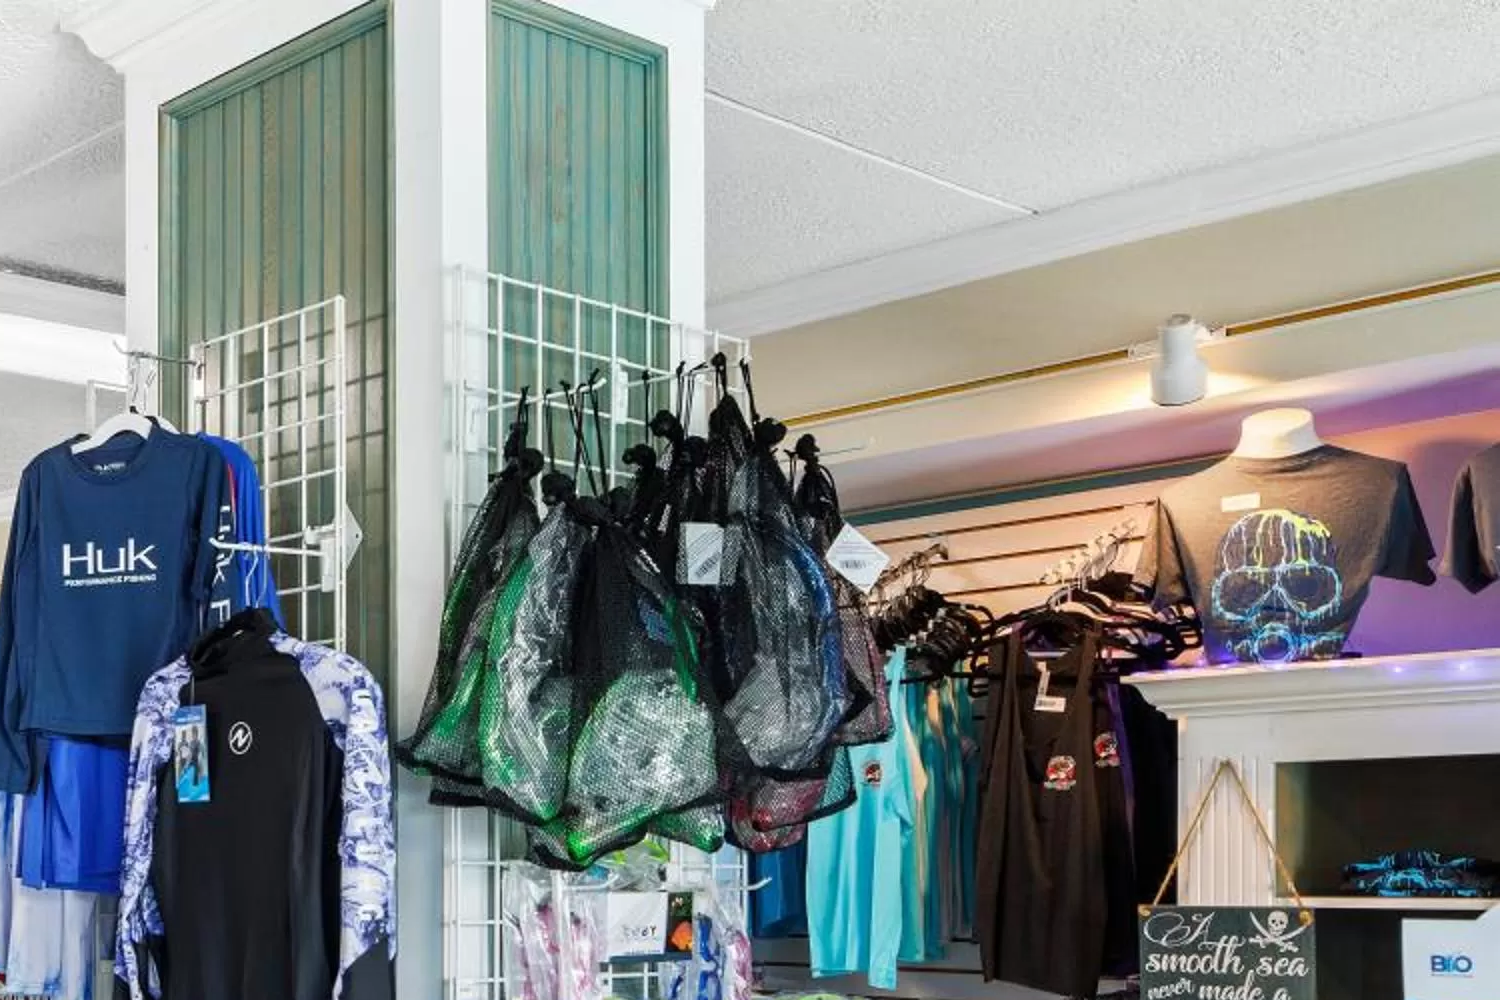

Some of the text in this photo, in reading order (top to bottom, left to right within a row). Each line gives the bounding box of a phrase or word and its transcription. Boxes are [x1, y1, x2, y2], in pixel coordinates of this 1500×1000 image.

[62, 536, 158, 577] Huk
[1145, 935, 1310, 977] smooth sea
[1147, 977, 1195, 1000] never
